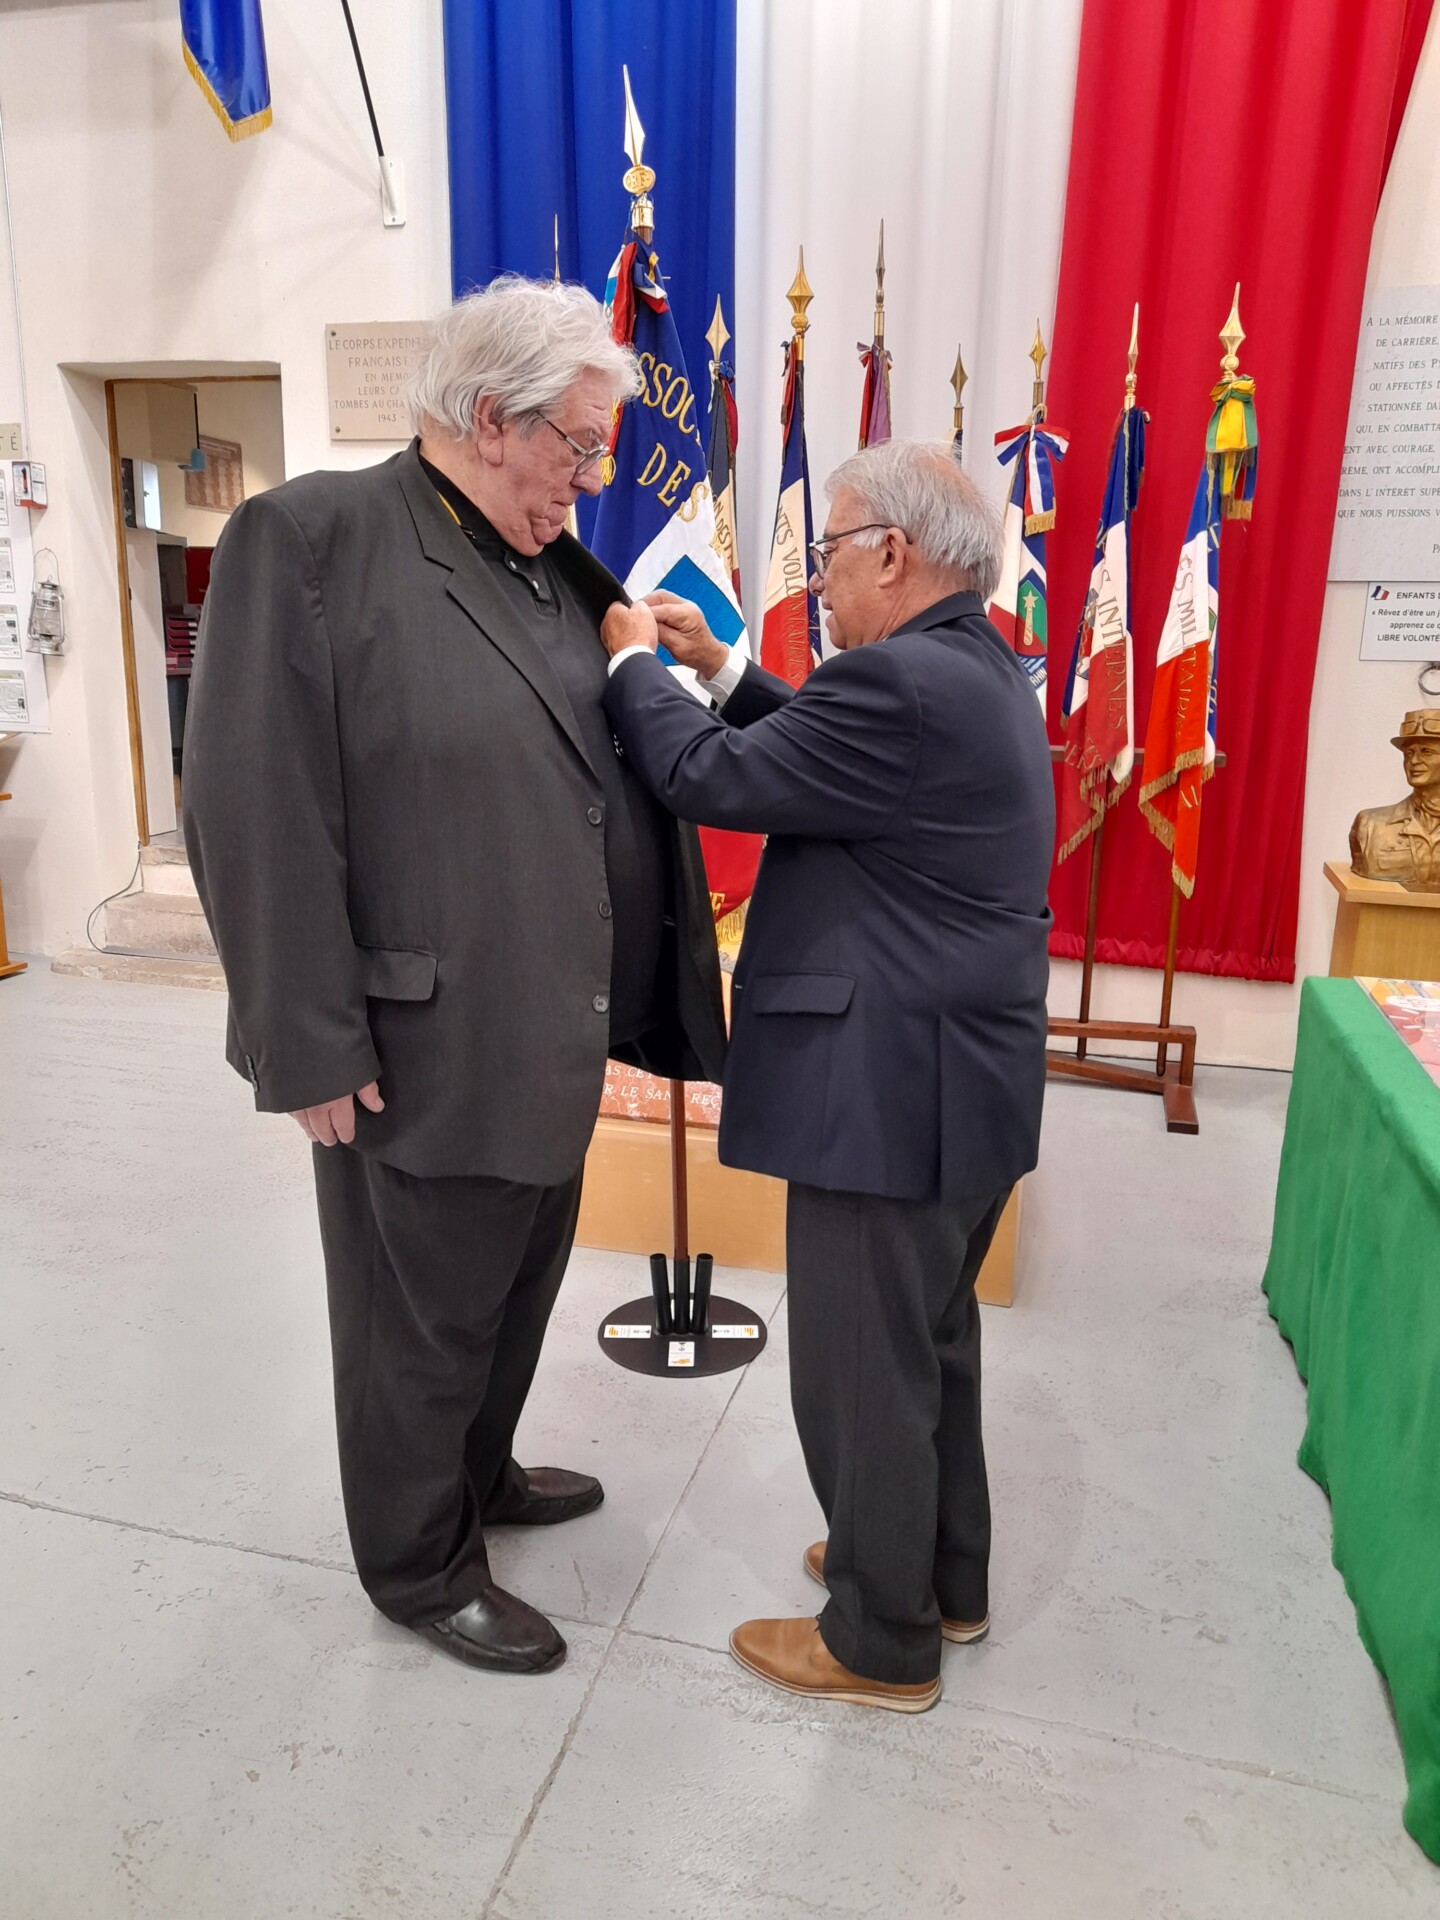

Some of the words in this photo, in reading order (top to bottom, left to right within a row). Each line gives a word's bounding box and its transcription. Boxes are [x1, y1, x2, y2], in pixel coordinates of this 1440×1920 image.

[1367, 317, 1373, 326] A
[1379, 318, 1390, 326] LA
[1395, 314, 1438, 325] MÉMOIRE
[328, 340, 341, 350] LE
[342, 338, 375, 350] CORPS
[1376, 339, 1387, 347] DE
[1373, 361, 1405, 370] NATIFS
[1408, 360, 1426, 369] DES
[365, 373, 377, 382] EN
[1369, 382, 1381, 391] OU
[1386, 380, 1433, 390] AFFECTÉS
[358, 386, 386, 396] LEURS
[334, 400, 369, 409] TOMBES
[372, 400, 385, 408] AU
[1367, 402, 1422, 412] STATIONNÉE
[378, 414, 397, 423] 1943
[1377, 424, 1390, 433] EN
[1365, 445, 1388, 454] AVEC
[1372, 466, 1391, 475] ONT
[637, 442, 709, 522] DES
[1338, 488, 1362, 497] DANS
[1337, 509, 1356, 519] QUE
[1360, 509, 1382, 518] NOUS
[1386, 509, 1431, 518] PUISSIONS
[1028, 666, 1047, 687] RHIN
[620, 1086, 639, 1098] LE
